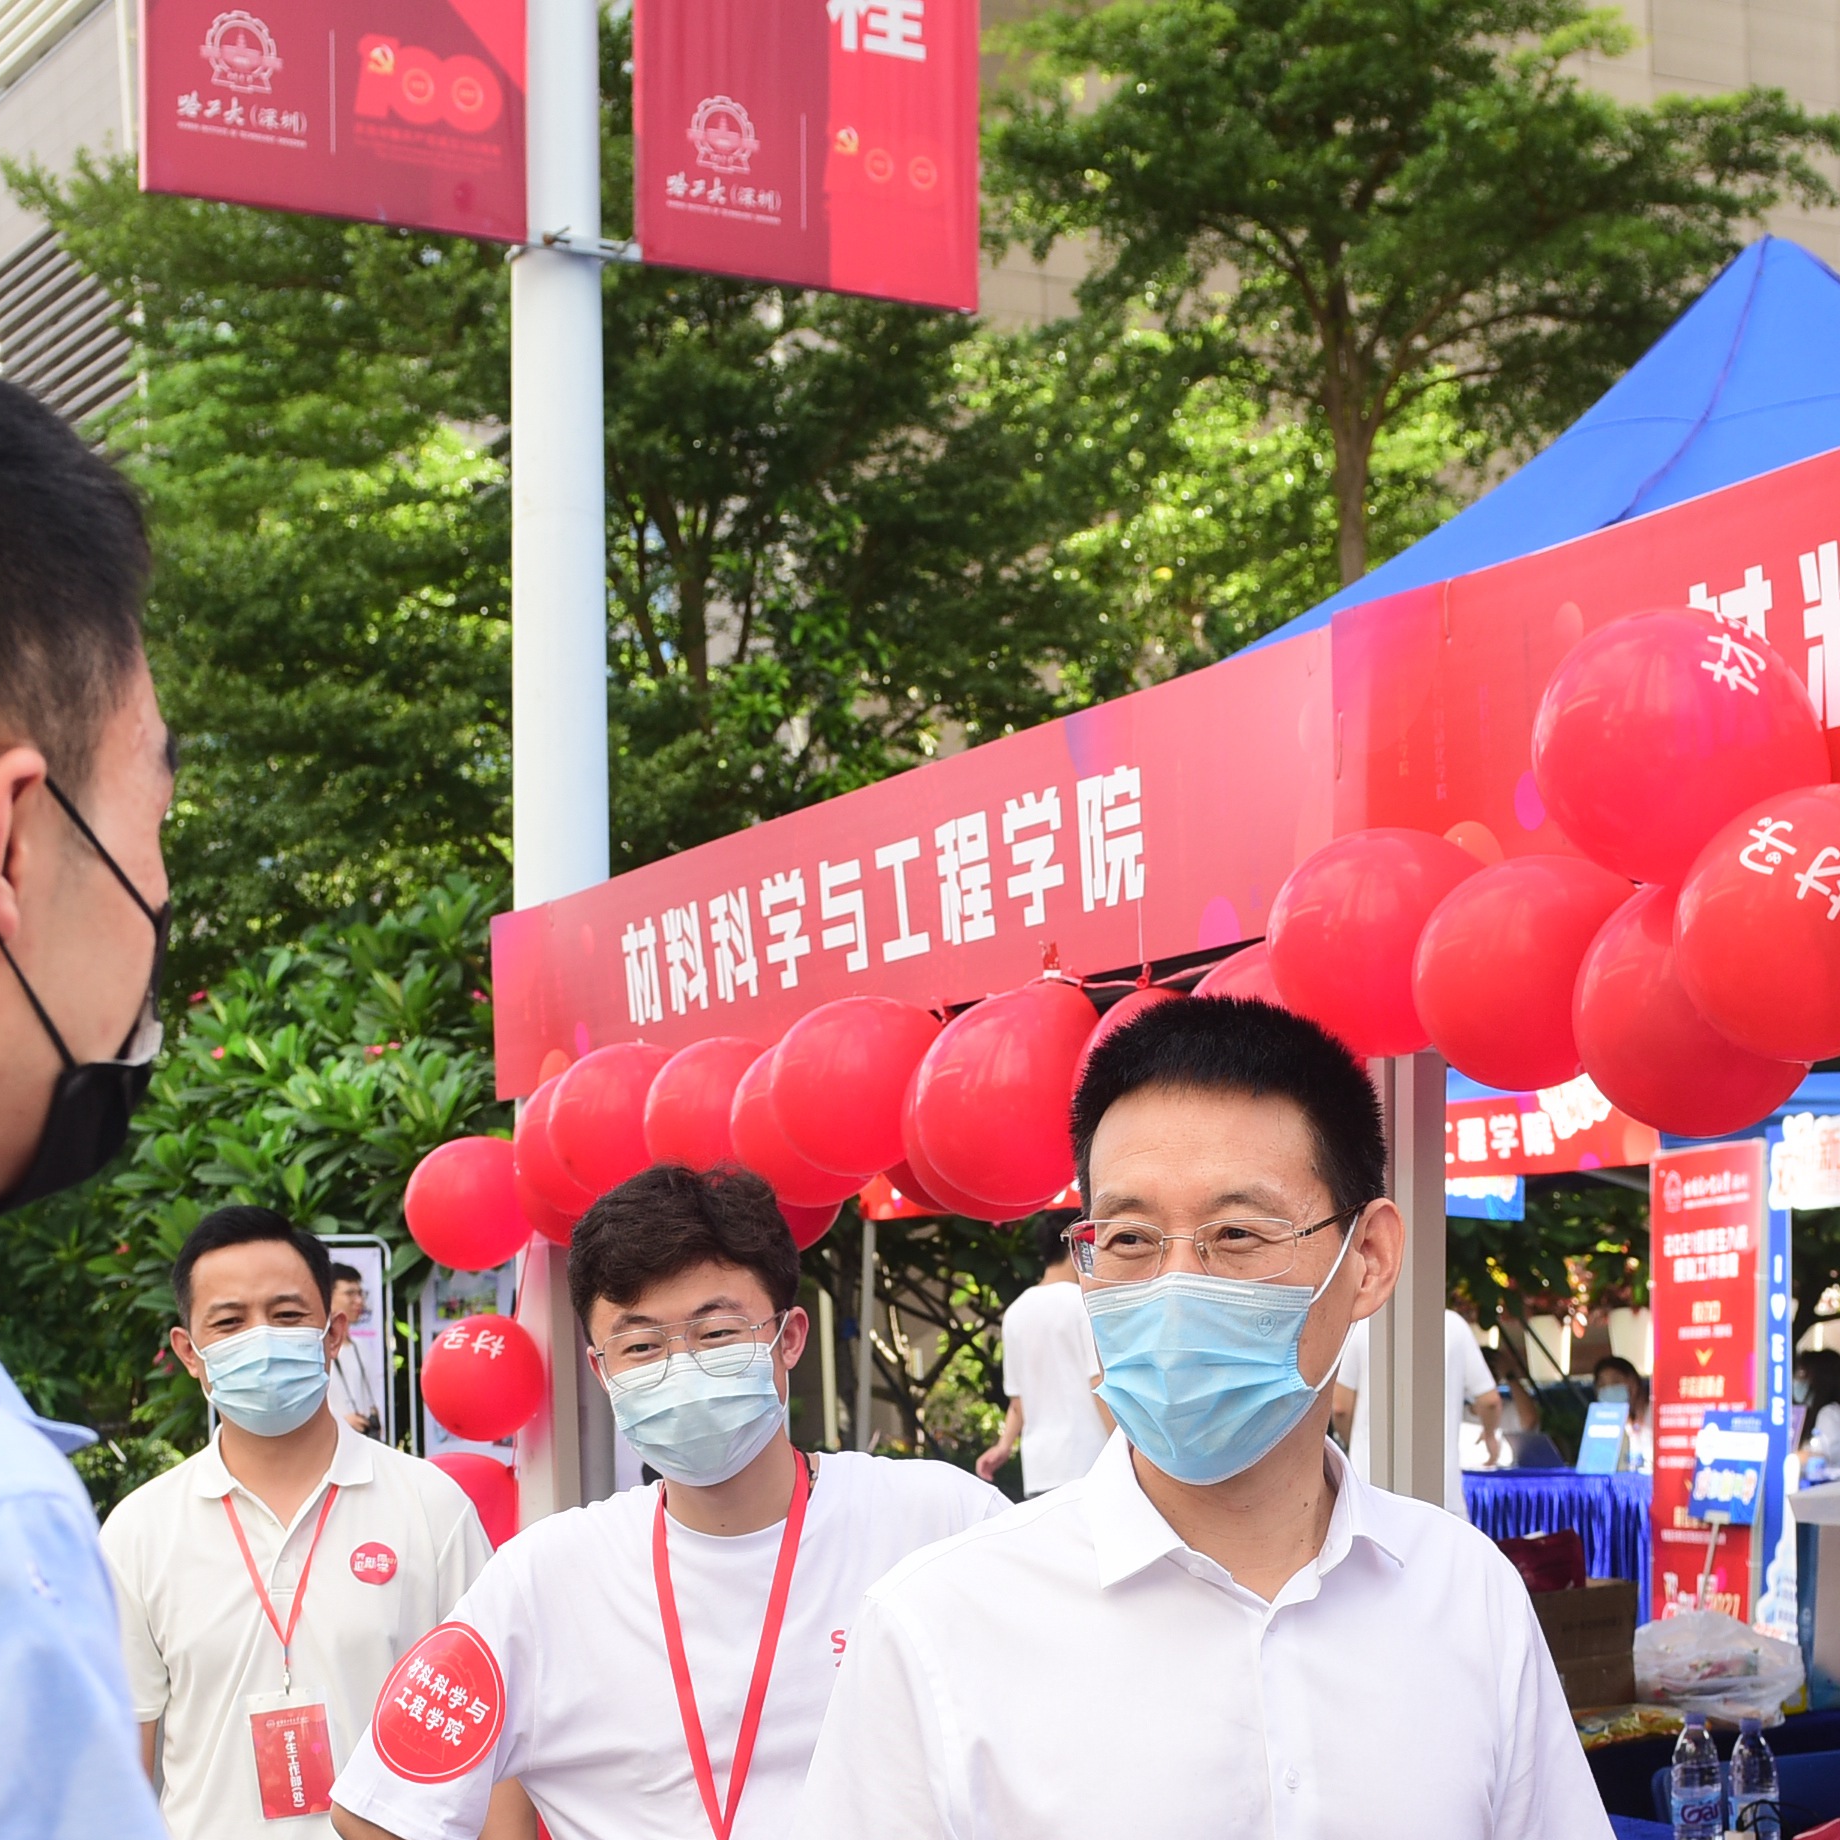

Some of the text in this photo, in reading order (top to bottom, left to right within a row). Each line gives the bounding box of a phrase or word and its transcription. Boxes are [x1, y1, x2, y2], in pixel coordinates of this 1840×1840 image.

[621, 765, 1145, 1027] 材料科学与工程学院
[394, 1686, 466, 1747] 工程学院
[407, 1656, 490, 1724] 材料科学与
[283, 1730, 306, 1808] 学生工作部(处)
